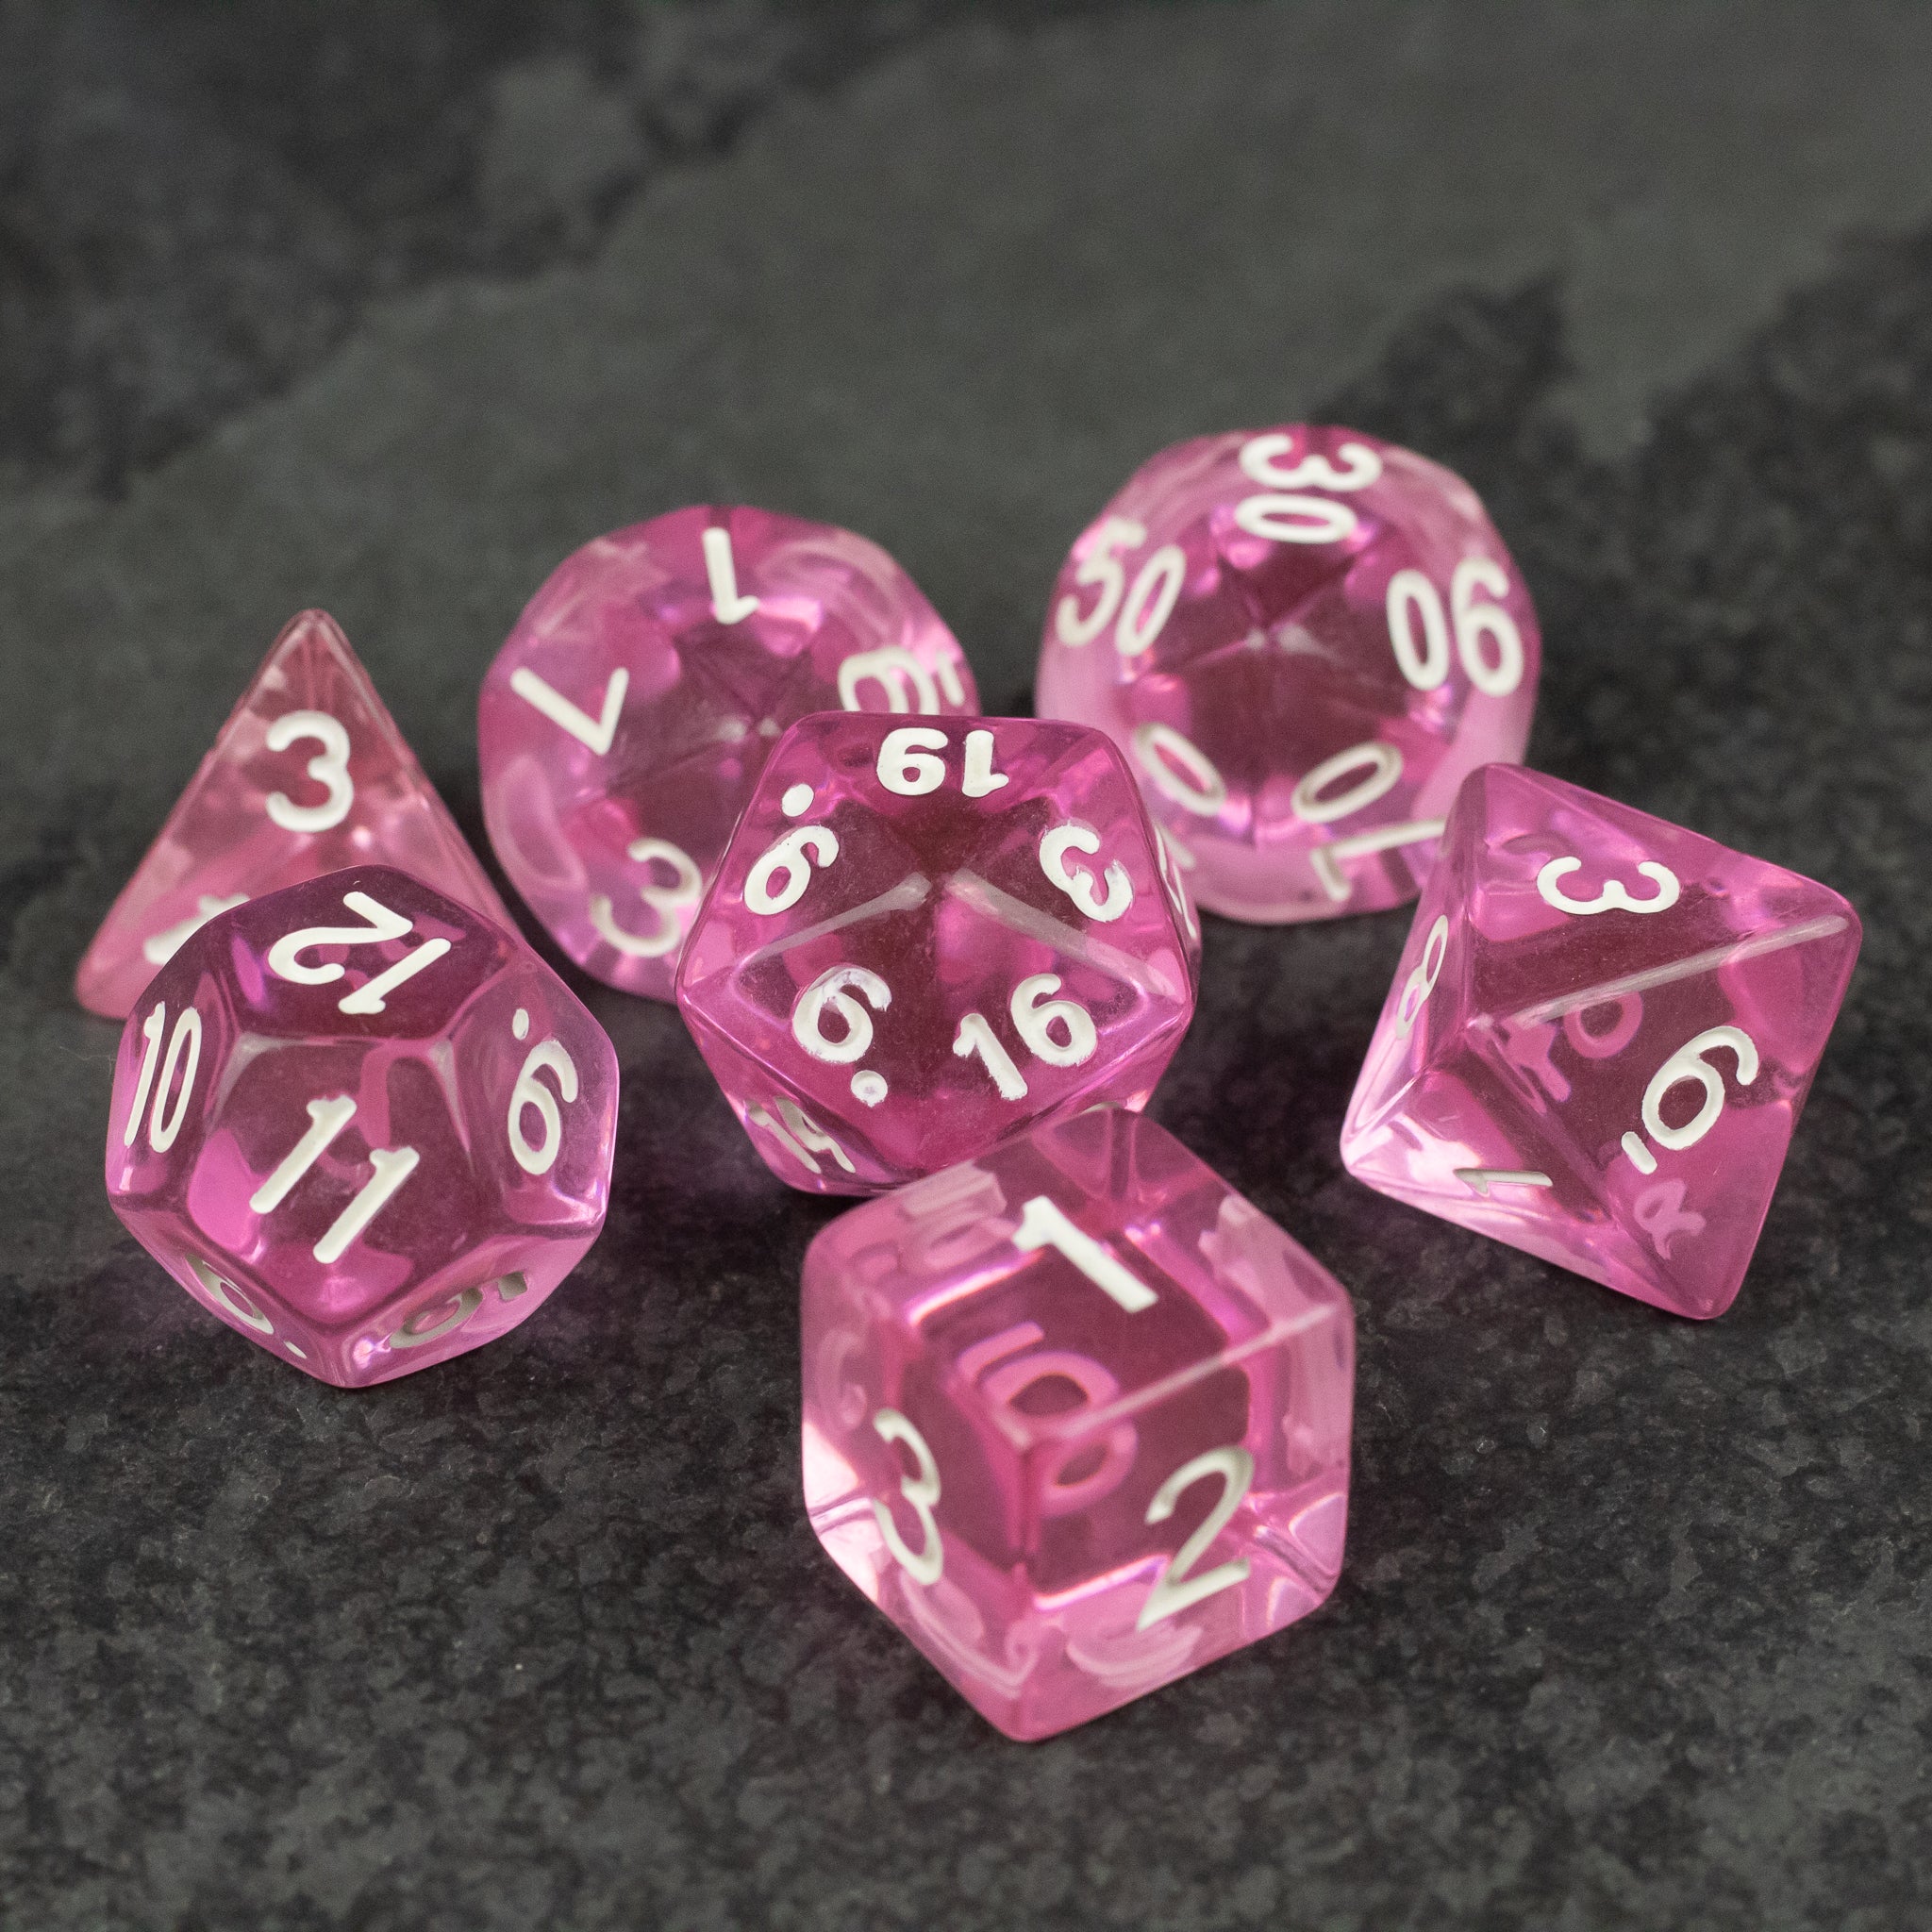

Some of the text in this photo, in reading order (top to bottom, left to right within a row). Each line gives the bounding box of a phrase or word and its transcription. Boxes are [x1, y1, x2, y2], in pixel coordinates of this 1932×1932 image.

[1239, 434, 1383, 544] 30
[702, 525, 760, 625] 1
[1055, 517, 1187, 658] 50
[1387, 556, 1524, 698] 90
[265, 709, 354, 833] 3
[509, 666, 629, 757] 7
[875, 727, 1009, 798] 19
[590, 837, 703, 958] 3
[1039, 820, 1134, 923] 3
[1537, 856, 1680, 915] 3
[268, 891, 451, 1015] 12
[124, 1001, 202, 1154] 10
[952, 972, 1098, 1101] 16
[249, 1094, 420, 1264] 11
[1012, 1194, 1158, 1313] 1
[874, 1408, 944, 1587] 3
[1137, 1446, 1255, 1633] 2
